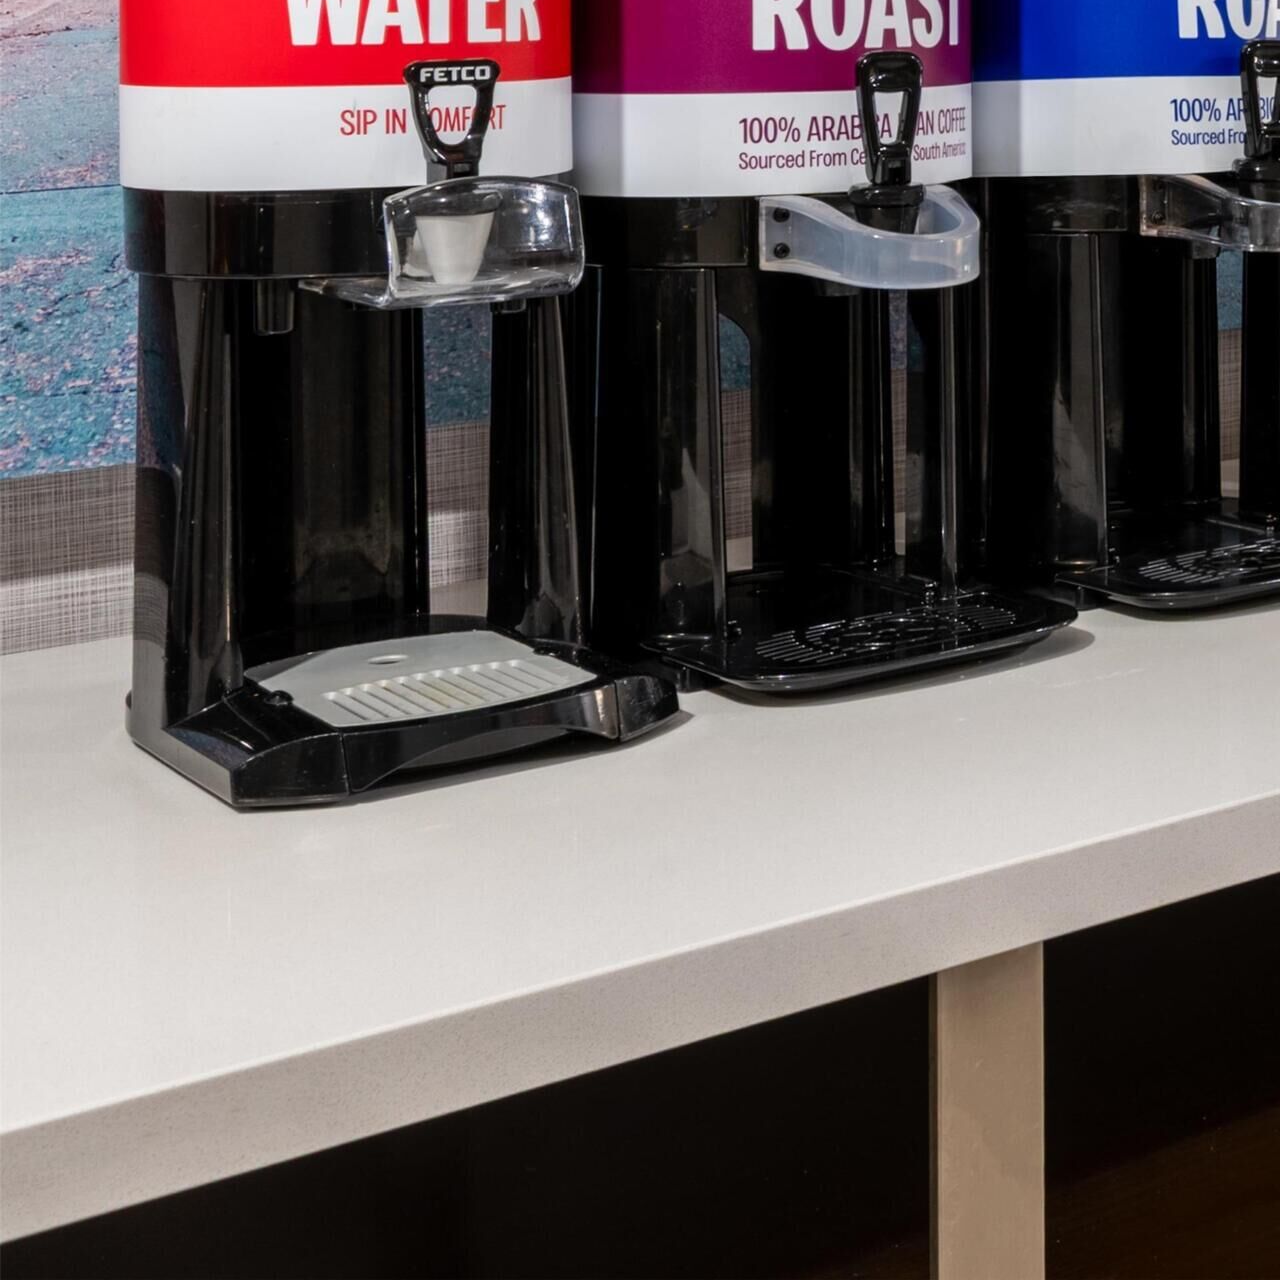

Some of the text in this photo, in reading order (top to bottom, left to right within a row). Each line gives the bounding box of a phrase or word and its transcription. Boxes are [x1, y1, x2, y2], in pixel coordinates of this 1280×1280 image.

[420, 65, 491, 82] FETCO
[340, 104, 506, 136] SIP IN OMFRT
[1170, 98, 1221, 122] 100%
[739, 117, 800, 144] 100%
[807, 113, 892, 142] ARABA
[1171, 129, 1247, 145] Sourced Fro
[738, 150, 805, 170] Sourced
[809, 149, 847, 167] From
[913, 143, 940, 161] South
